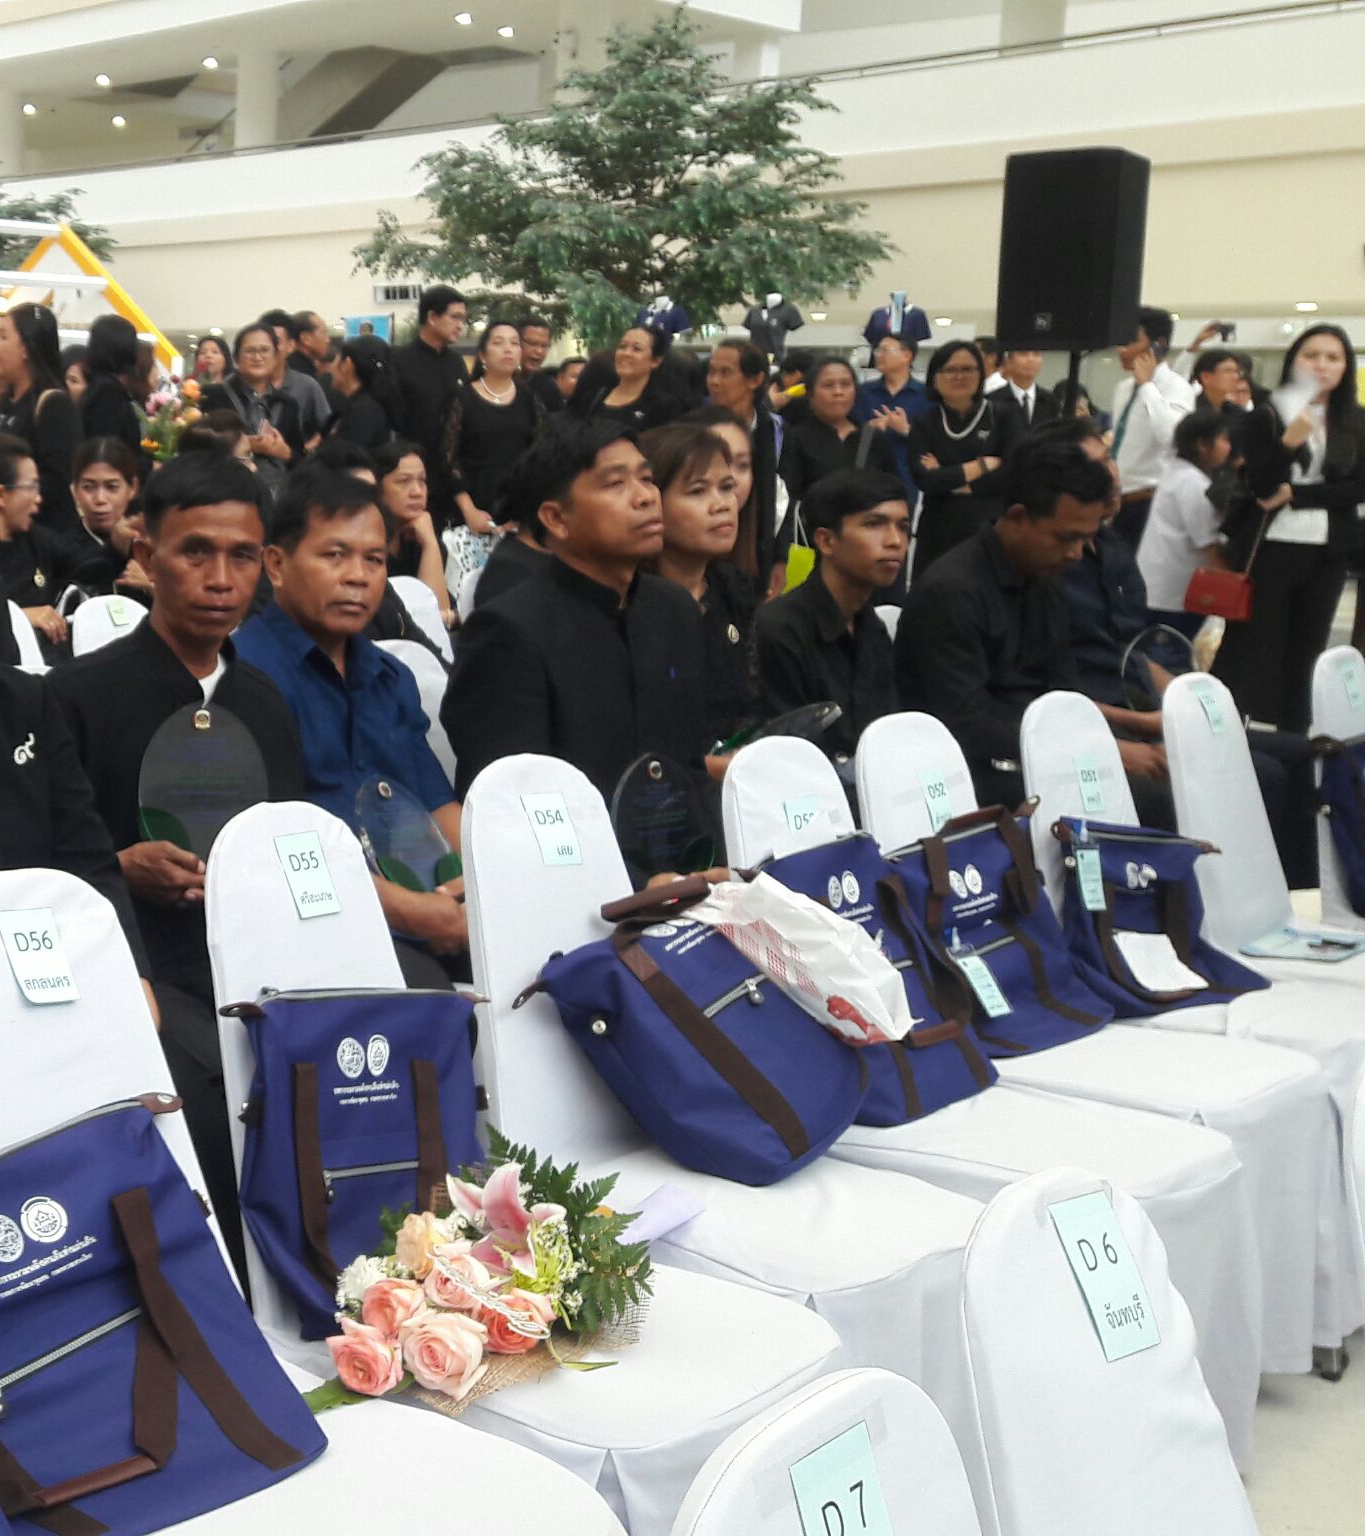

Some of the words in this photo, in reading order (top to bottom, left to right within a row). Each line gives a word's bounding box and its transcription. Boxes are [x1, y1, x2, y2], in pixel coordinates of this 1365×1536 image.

[534, 809, 564, 825] D54
[288, 850, 320, 872] D55
[14, 929, 54, 952] D56
[1104, 1293, 1145, 1330] จันทบุรี
